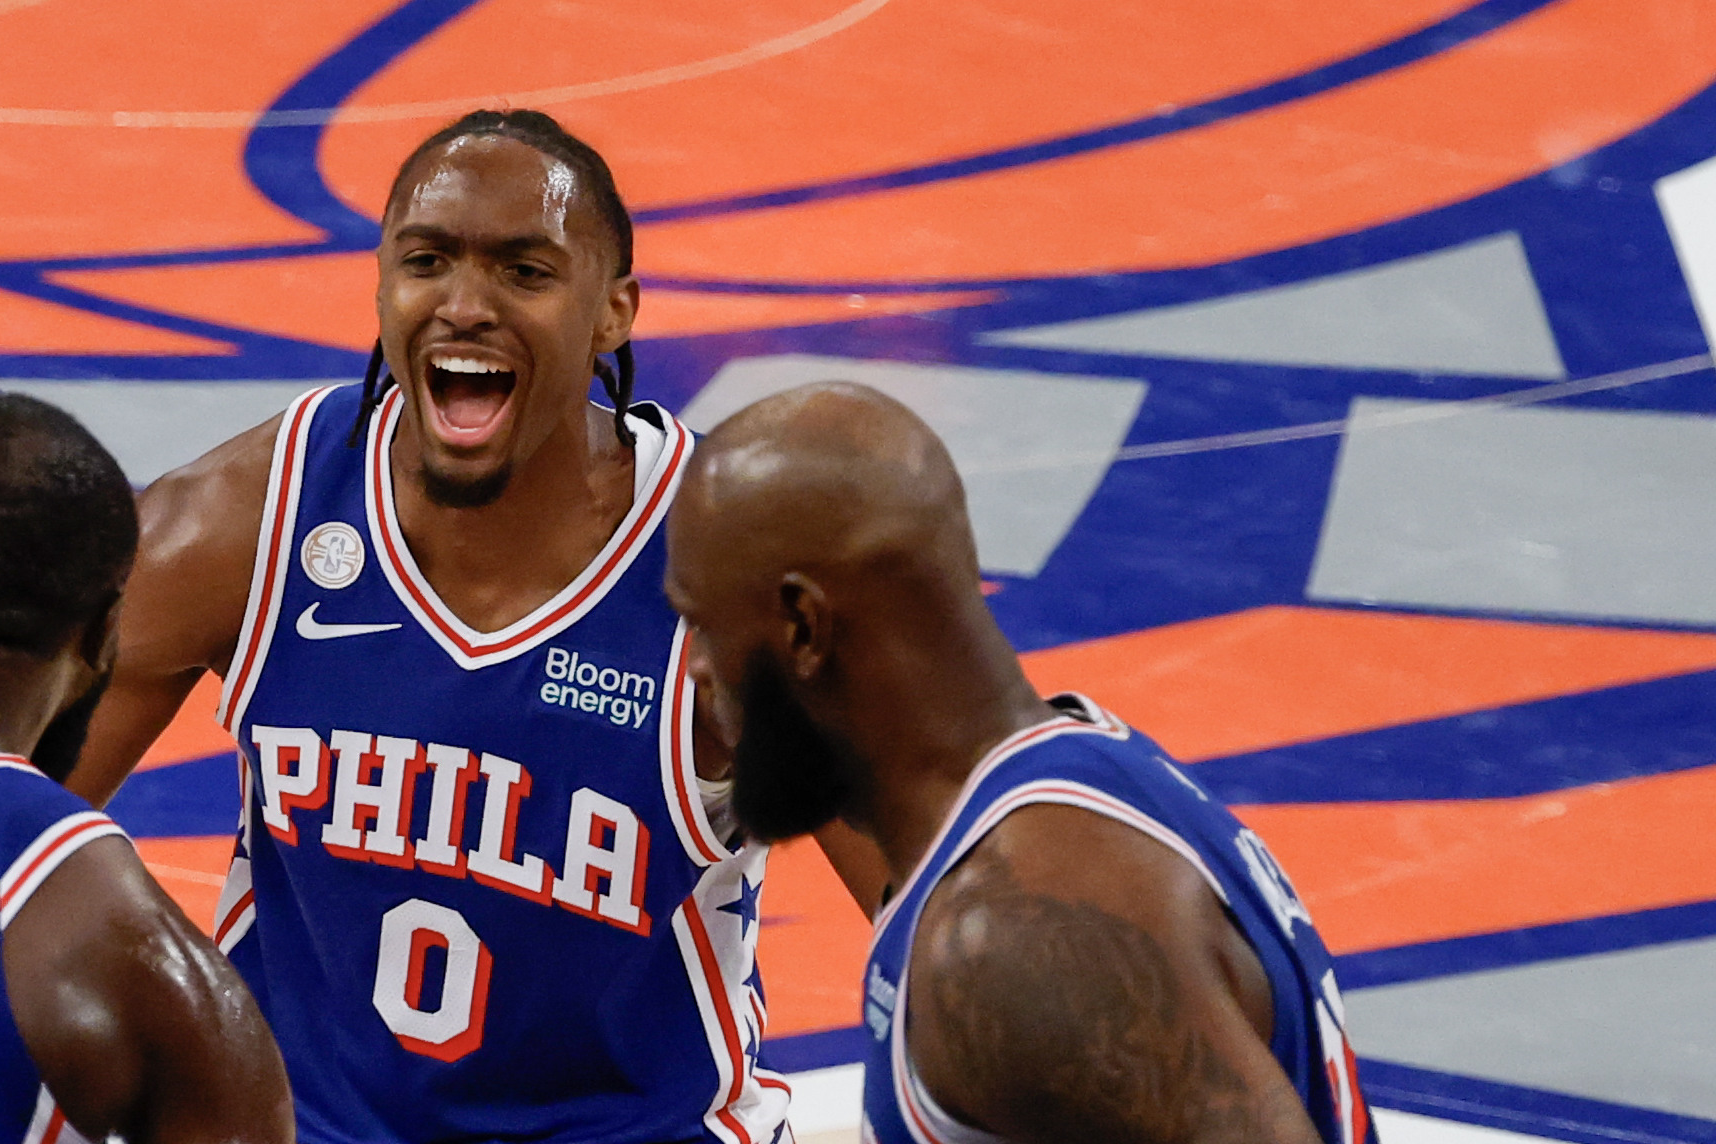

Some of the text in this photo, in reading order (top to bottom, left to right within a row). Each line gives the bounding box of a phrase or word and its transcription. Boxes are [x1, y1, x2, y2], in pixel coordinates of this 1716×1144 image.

[540, 681, 651, 729] energy
[545, 647, 656, 701] Bloom
[251, 725, 652, 936] PHILA
[373, 898, 493, 1062] 0
